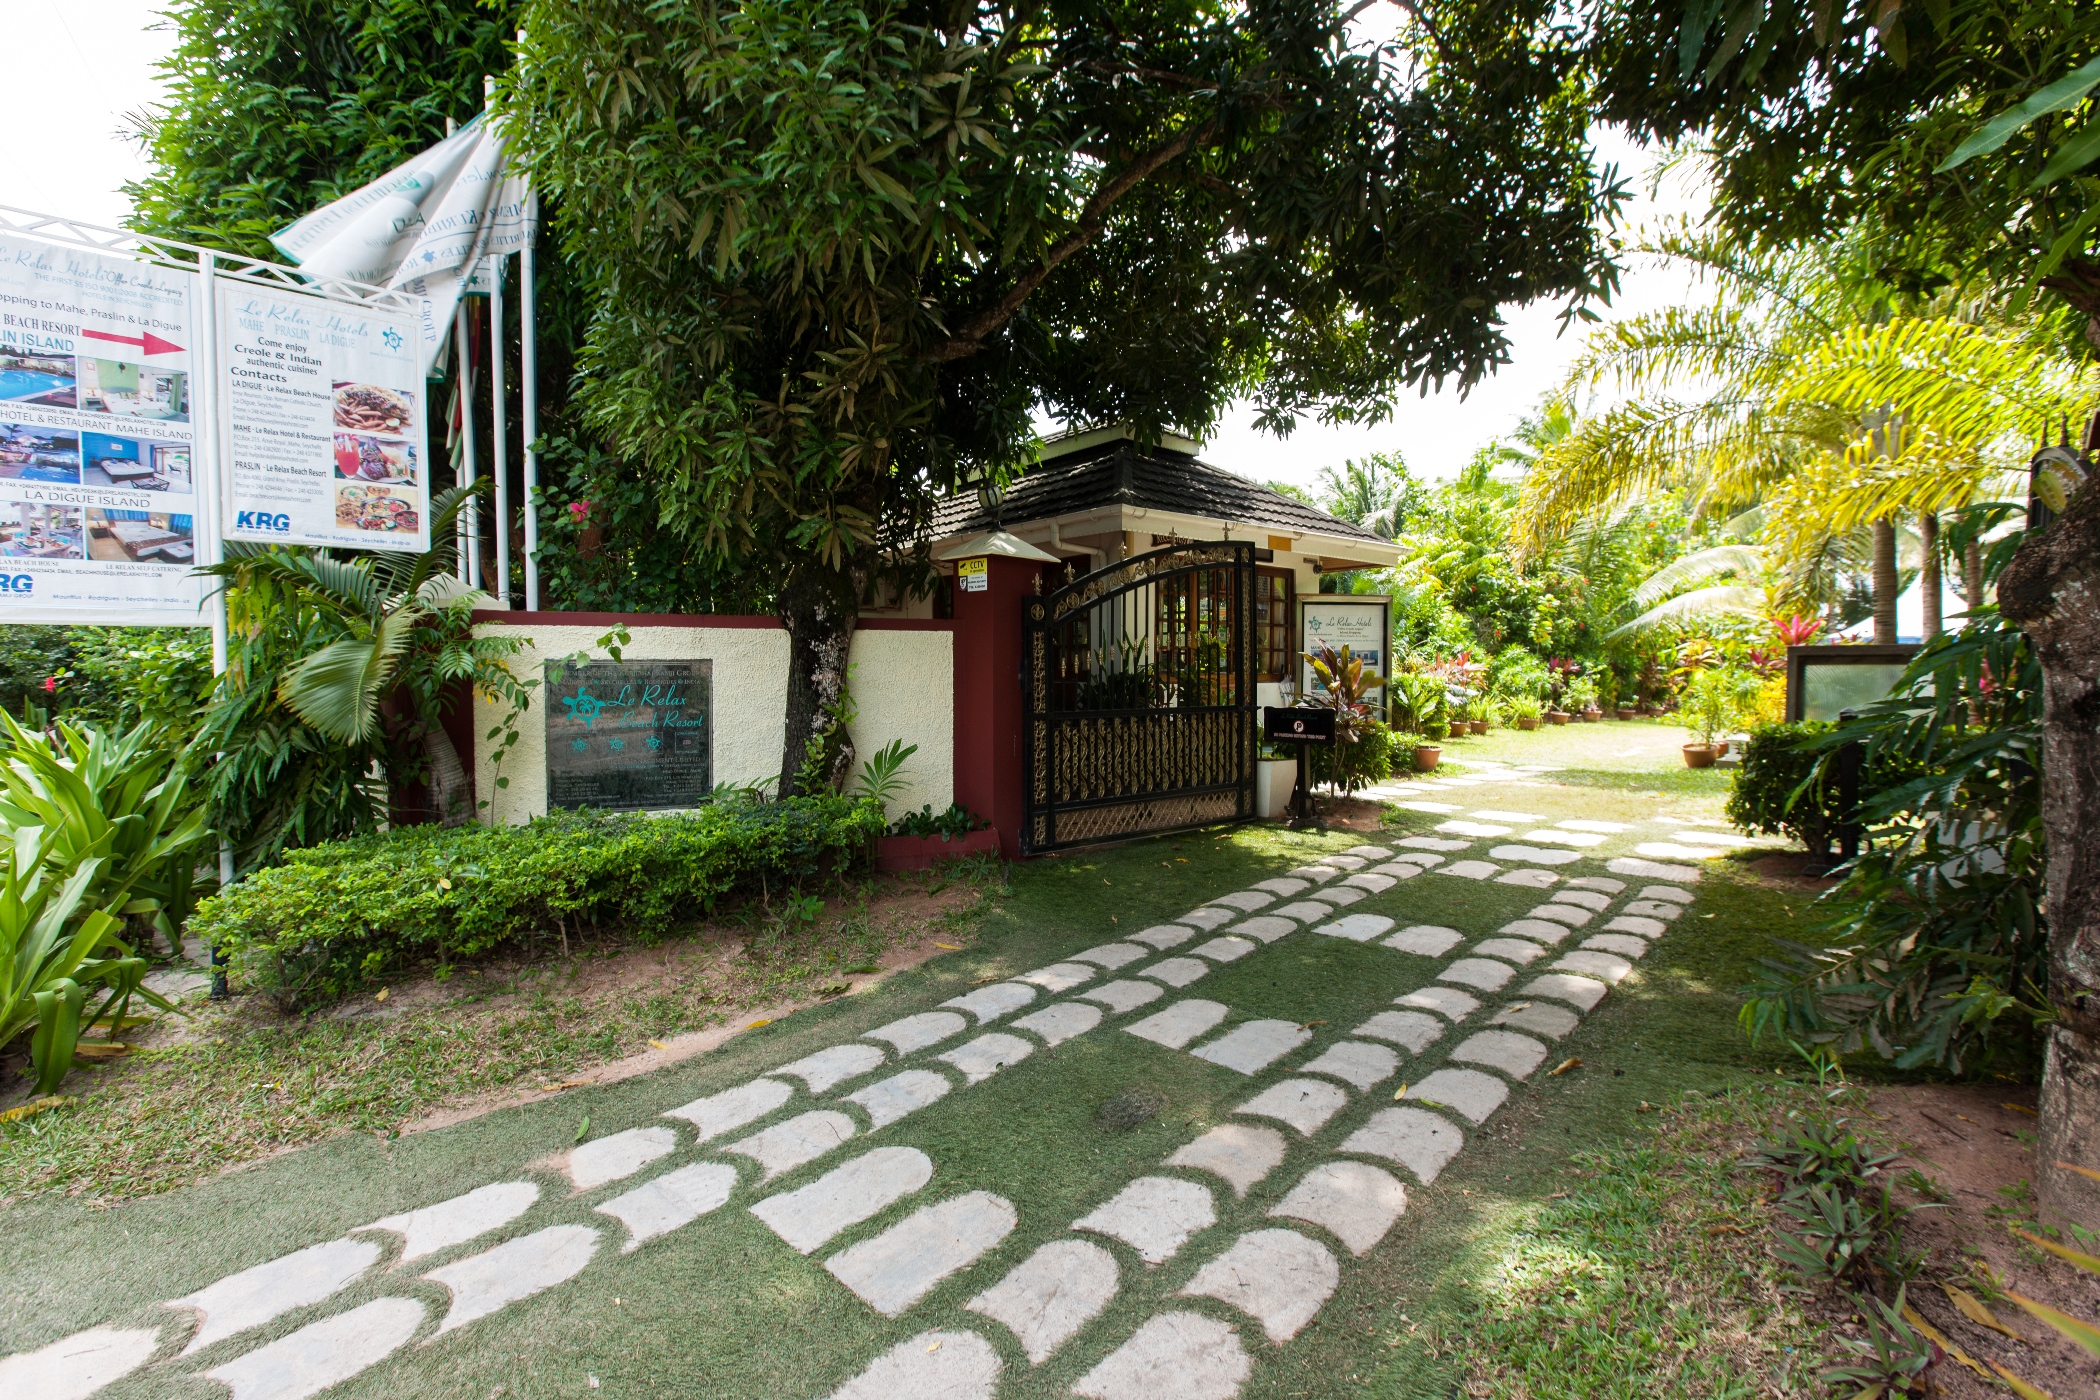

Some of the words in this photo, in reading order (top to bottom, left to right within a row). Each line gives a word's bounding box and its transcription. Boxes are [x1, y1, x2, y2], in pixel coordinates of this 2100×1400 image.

[15, 249, 53, 272] Relax
[58, 261, 104, 281] Hotels
[130, 278, 153, 290] Creole
[35, 272, 50, 282] THE
[52, 275, 72, 286] FIRST
[85, 282, 98, 290] ISO
[139, 292, 184, 306] ACCREDITED
[82, 291, 107, 301] HOTELS
[115, 297, 153, 309] SEYCHELLES
[0, 294, 37, 309] opping
[41, 298, 52, 309] to
[55, 302, 88, 316] Mahe,
[91, 308, 126, 322] Praslin
[128, 316, 136, 324] &
[138, 317, 150, 327] La
[152, 319, 182, 332] Digue
[236, 300, 262, 316] Le
[267, 304, 310, 326] Relax
[316, 316, 368, 337] Hotels
[4, 314, 39, 329] BEACH
[42, 321, 81, 337] RESORT
[239, 317, 264, 332] MAHE
[275, 324, 309, 341] PRASLIN
[320, 332, 331, 344] LA
[331, 334, 356, 349] DIGUE
[22, 332, 75, 352] ISLAND
[257, 336, 283, 349] Come
[285, 342, 307, 354] enjoy
[234, 344, 271, 358] Creole
[275, 352, 286, 360] &
[290, 354, 322, 367] Indian
[231, 366, 288, 383] Contacts
[246, 357, 285, 371] authentic
[287, 364, 318, 376] cuisines
[242, 381, 262, 390] DIGUE
[275, 386, 292, 395] Relax
[293, 389, 311, 398] Beach
[312, 392, 331, 400] House
[1, 410, 34, 424] HOTEL
[37, 414, 46, 423] &
[47, 416, 112, 431] RESTAURANT
[116, 424, 150, 436] MAHE
[152, 429, 193, 440] ISLAND
[233, 423, 251, 432] MAHE
[263, 427, 279, 435] Relax
[280, 430, 295, 438] Hotel
[296, 431, 301, 439] &
[301, 433, 331, 442] Restaurant
[235, 460, 261, 470] PRASLIN
[266, 464, 274, 472] Le
[274, 465, 290, 474] Relax
[291, 466, 307, 475] Beach
[308, 468, 326, 477] Resort
[25, 490, 44, 500] LA
[49, 492, 96, 505] DIGUE
[99, 494, 151, 509] ISLAND
[237, 510, 291, 532] KRG
[361, 537, 388, 545] Seychelles
[14, 560, 37, 568] BEACH
[114, 564, 136, 572] RELAX
[969, 560, 984, 570] CCTV
[0, 574, 34, 593] RG
[1326, 617, 1335, 626] Le
[1337, 616, 1352, 626] Relax
[1352, 617, 1372, 626] Hotels
[592, 669, 601, 677] OF
[676, 669, 701, 677] GROUP
[607, 685, 635, 707] Le
[641, 684, 687, 706] Relax
[618, 711, 659, 728] Beach
[662, 710, 703, 728] Resort
